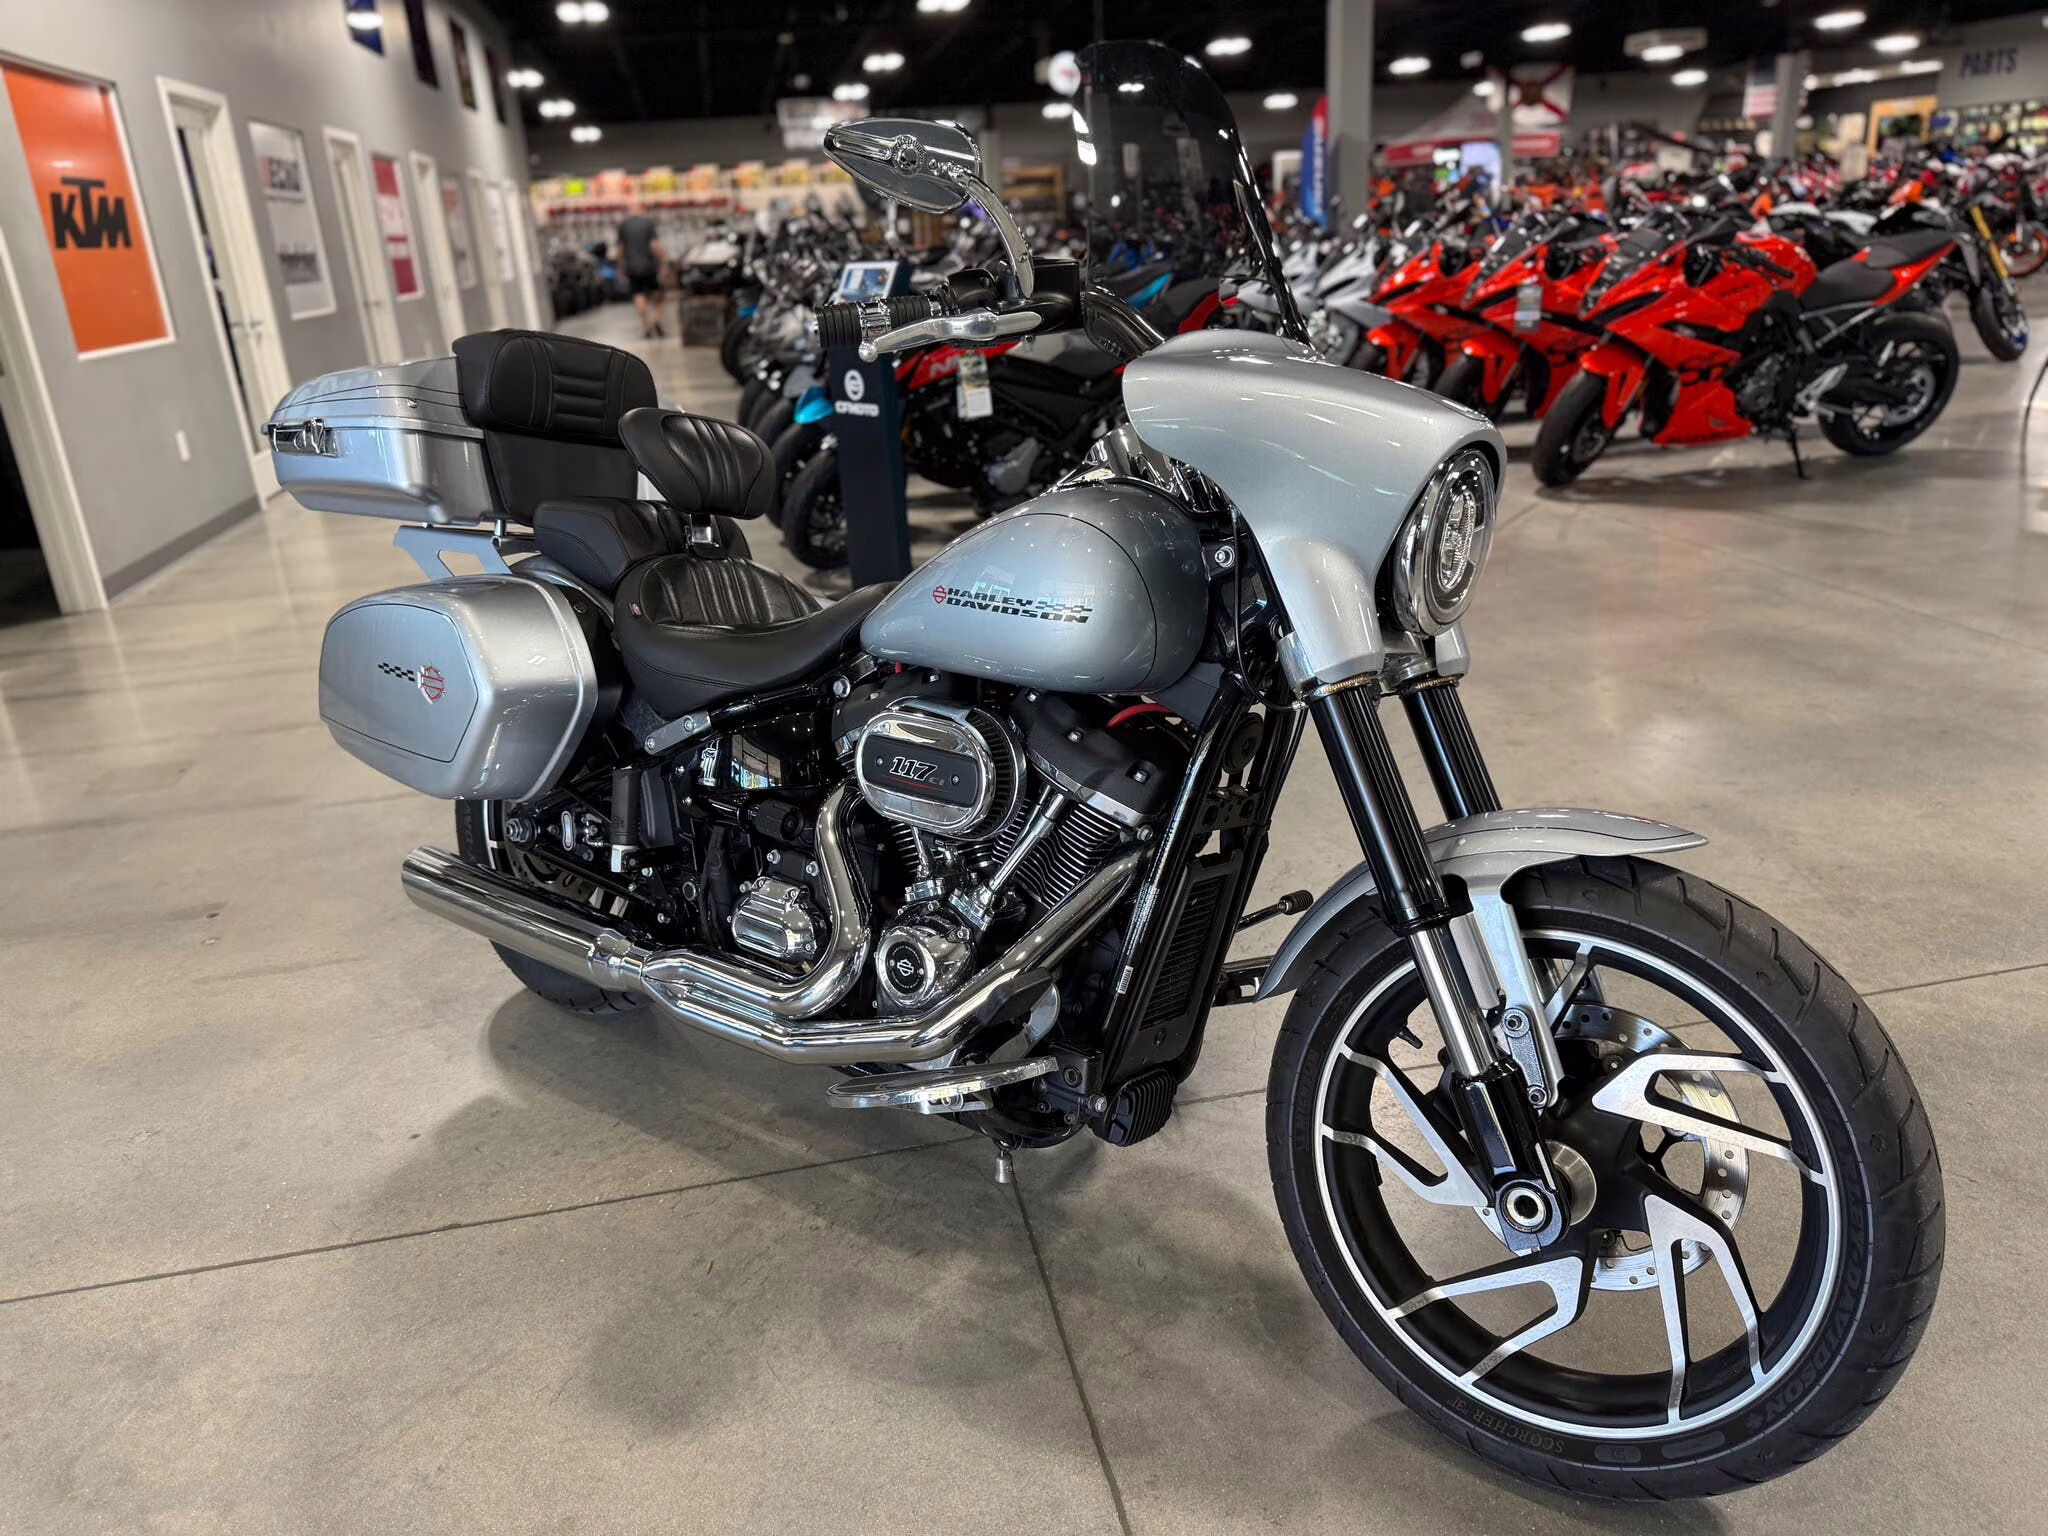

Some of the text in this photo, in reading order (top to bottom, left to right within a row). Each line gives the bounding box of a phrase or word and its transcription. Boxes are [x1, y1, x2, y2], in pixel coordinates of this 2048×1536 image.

[49, 176, 132, 250] KTM
[946, 597, 1090, 624] DAVIDSON
[947, 587, 1034, 607] HARLEY
[889, 756, 938, 782] 117
[1472, 1408, 1566, 1454] SCORCHER
